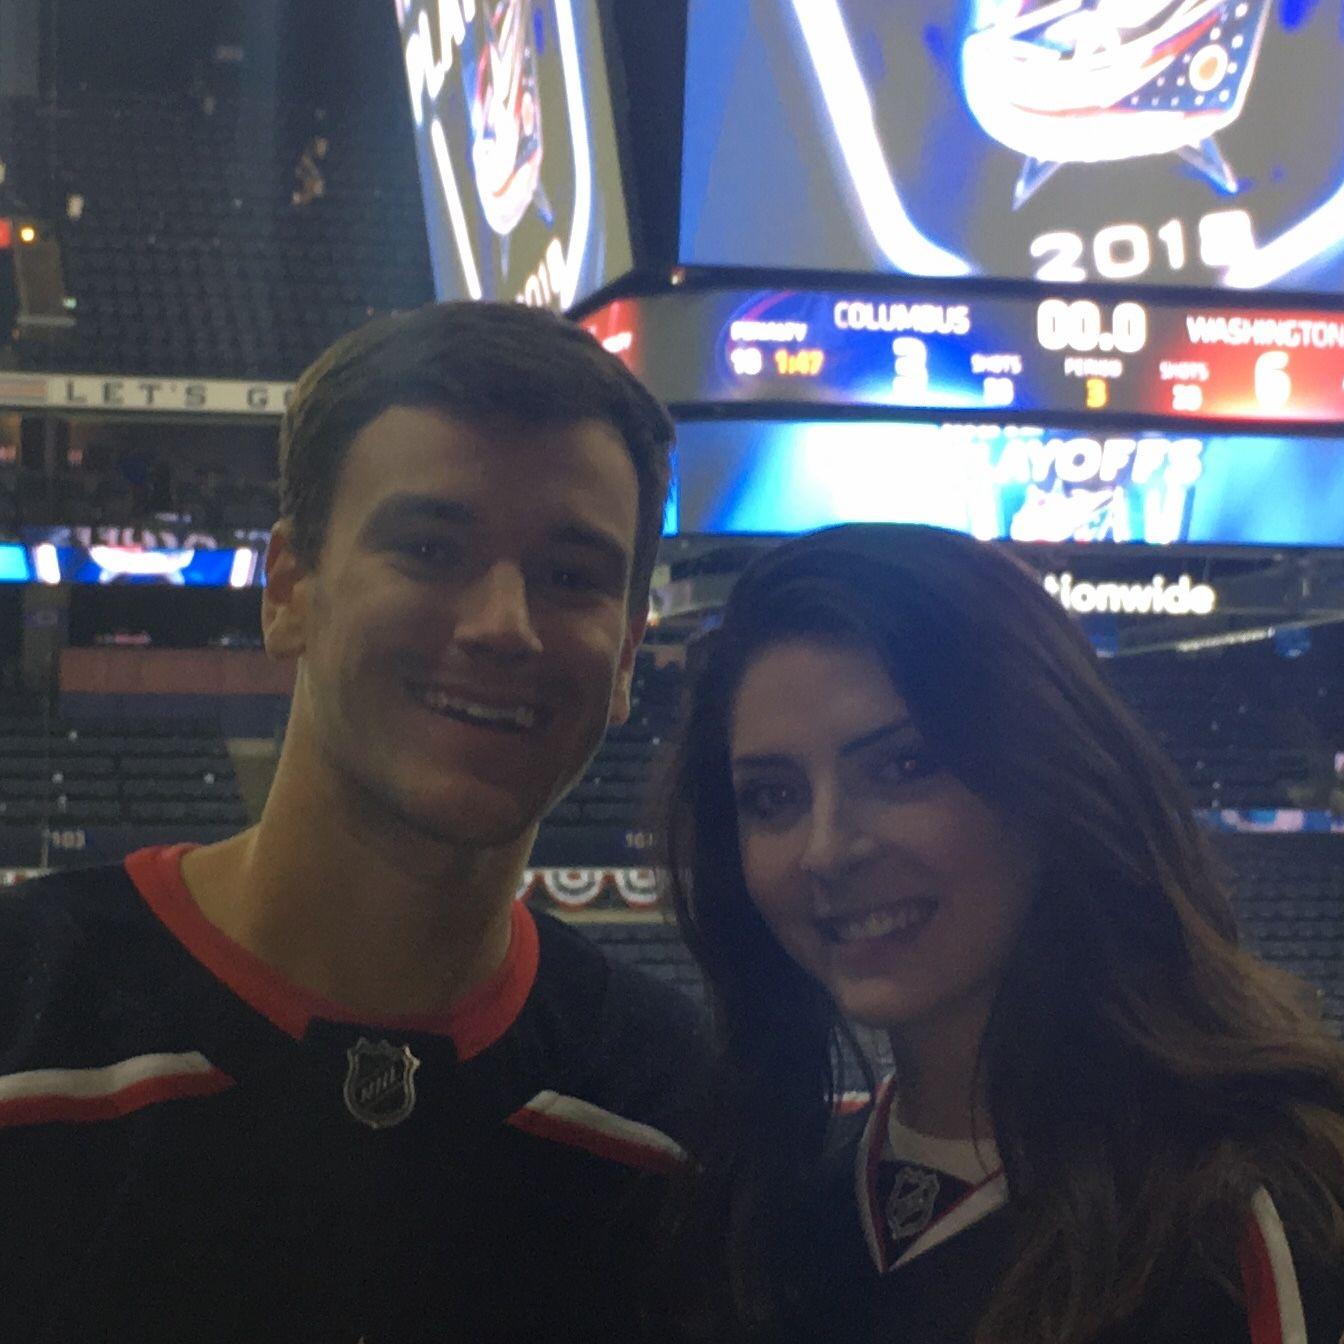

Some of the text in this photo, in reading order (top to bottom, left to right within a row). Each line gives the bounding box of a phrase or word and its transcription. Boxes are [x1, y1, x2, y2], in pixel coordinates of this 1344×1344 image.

[833, 300, 971, 336] COLUMBUS
[1036, 298, 1147, 354] 00.0
[65, 378, 208, 408] LET'S
[1085, 377, 1108, 409] 3
[1254, 350, 1292, 410] 6
